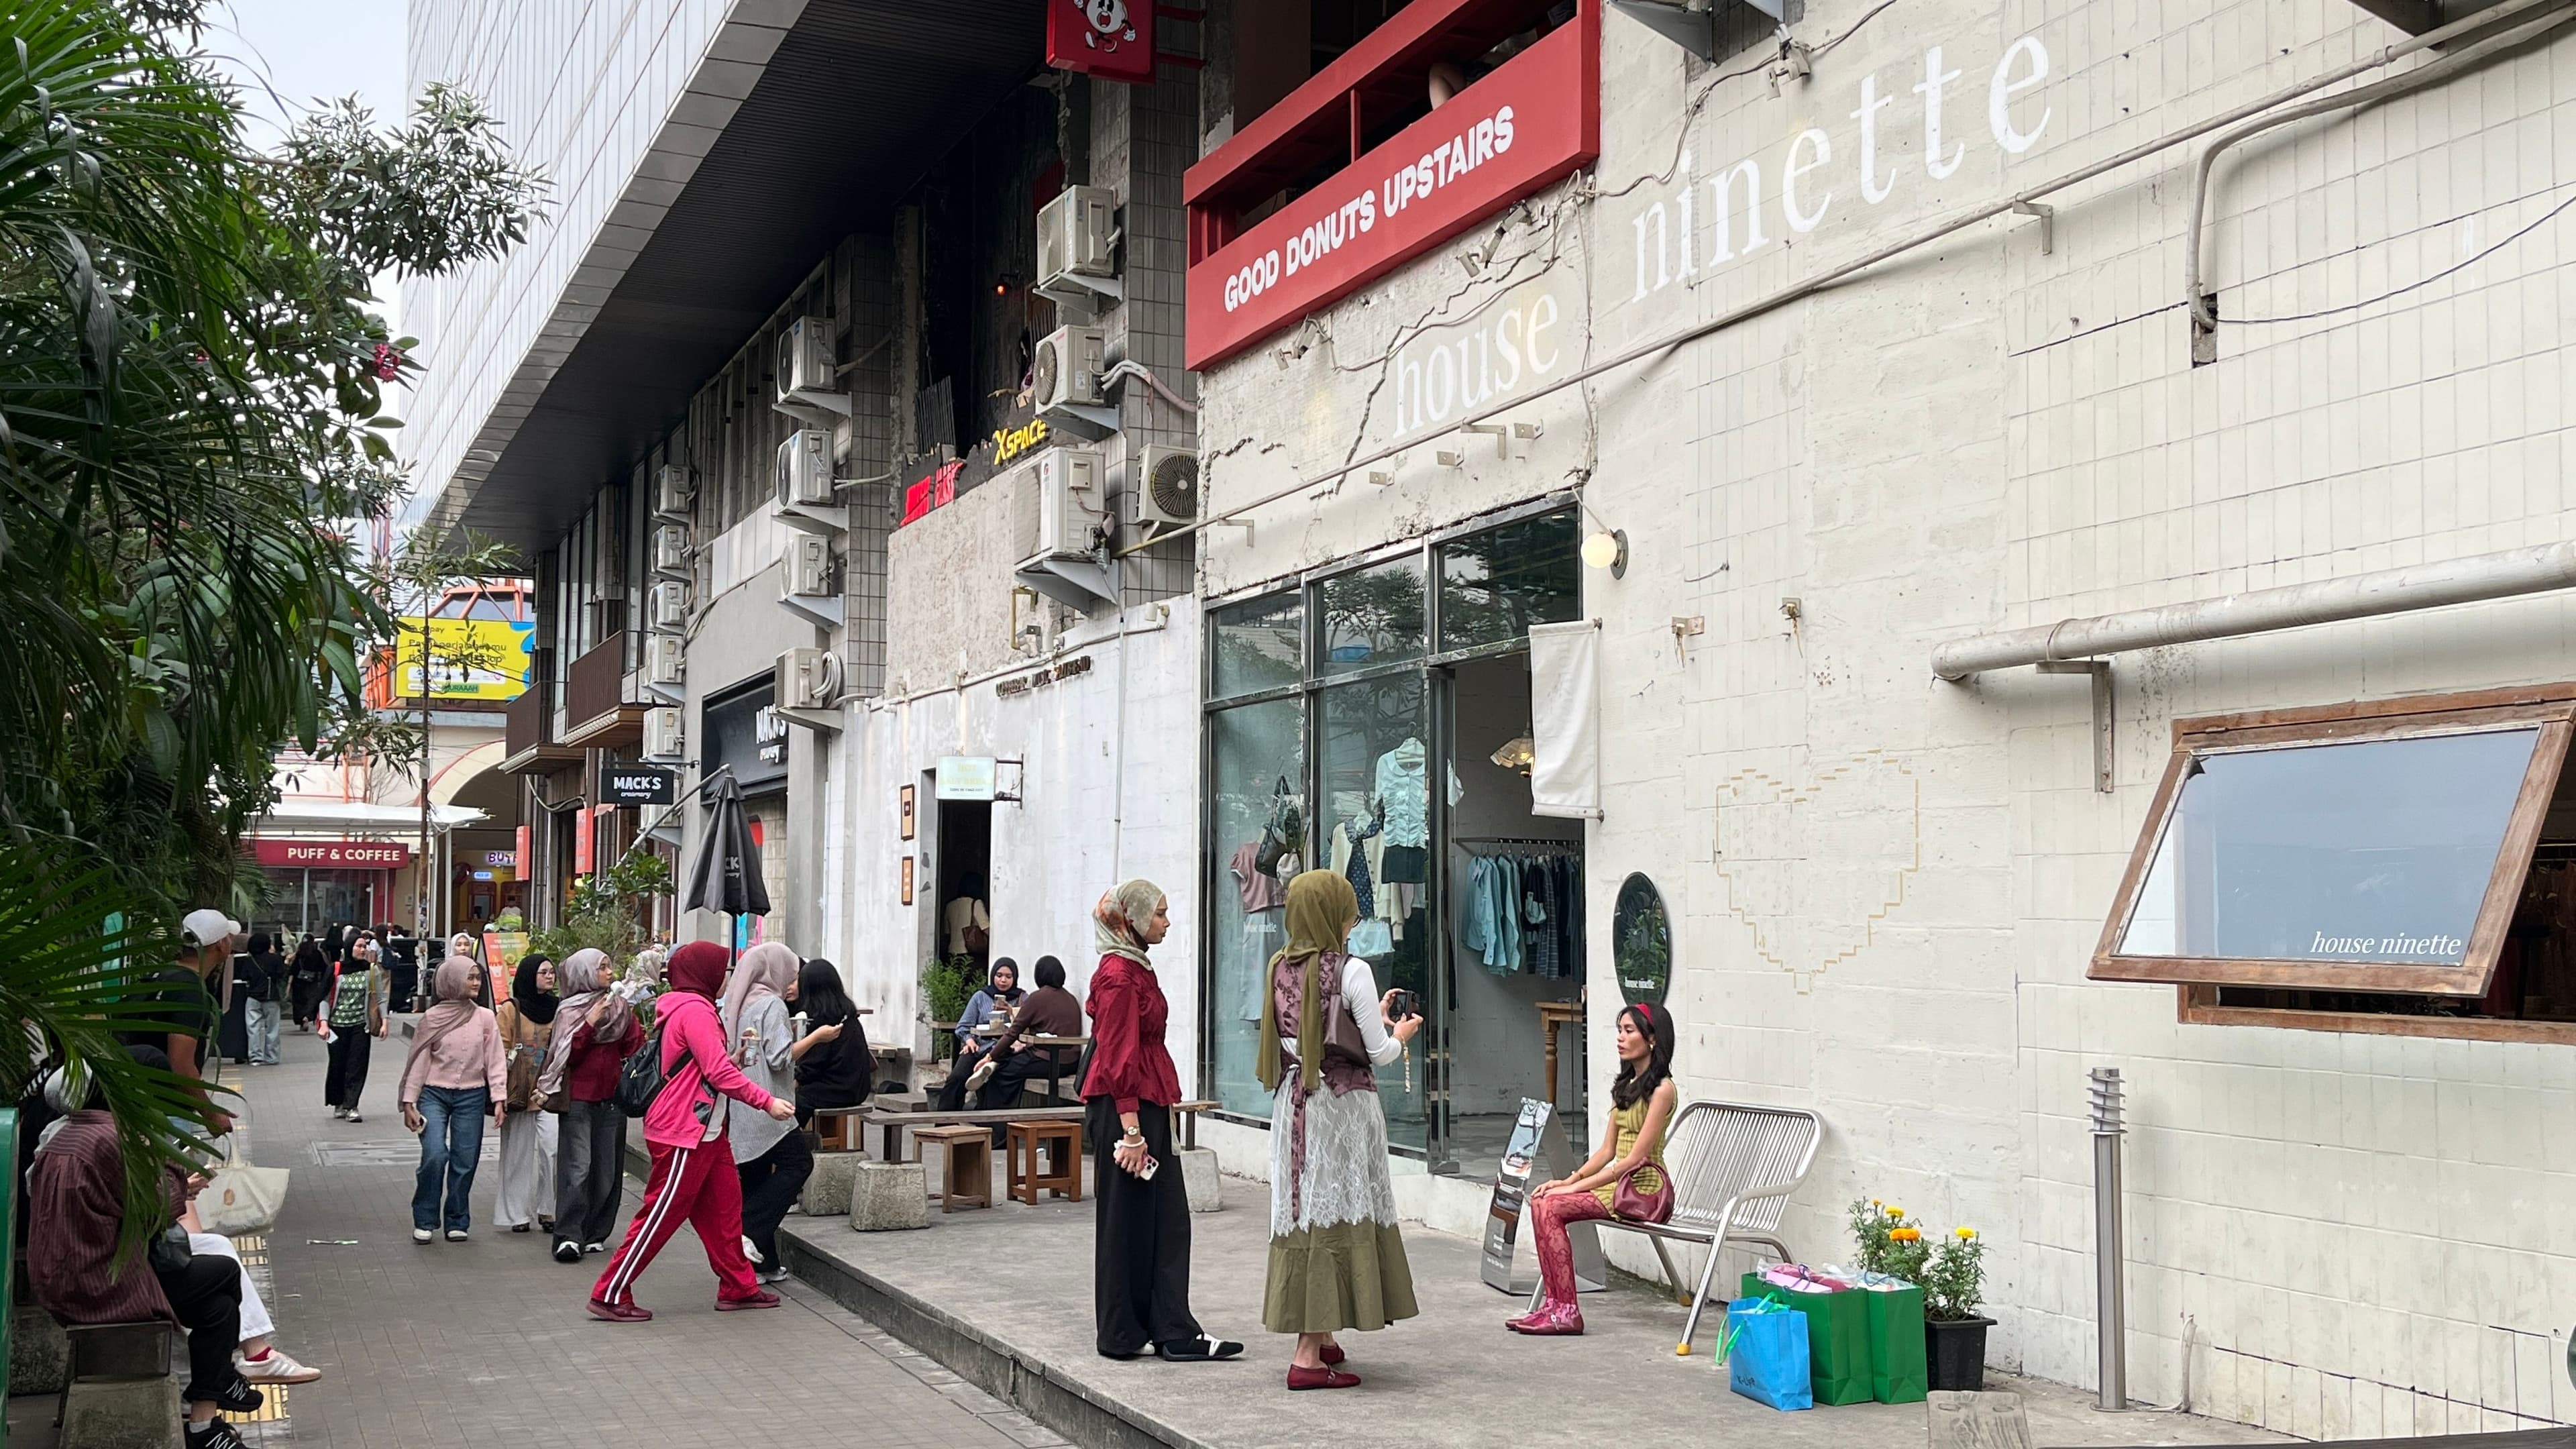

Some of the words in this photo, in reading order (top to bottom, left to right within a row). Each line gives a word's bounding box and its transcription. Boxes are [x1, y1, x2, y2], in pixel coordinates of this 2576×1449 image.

[1224, 250, 1279, 313] GOOD
[1286, 190, 1375, 277] DONUTS
[1384, 105, 1514, 217] UPSTAIRS
[1633, 36, 2051, 303] ninette
[1393, 294, 1559, 439] house
[613, 776, 661, 790] MACK'S
[288, 847, 325, 860] PUFF
[329, 849, 340, 859] &
[344, 849, 400, 861] COFFEE
[2310, 931, 2375, 954] house
[2378, 932, 2462, 955] ninette
